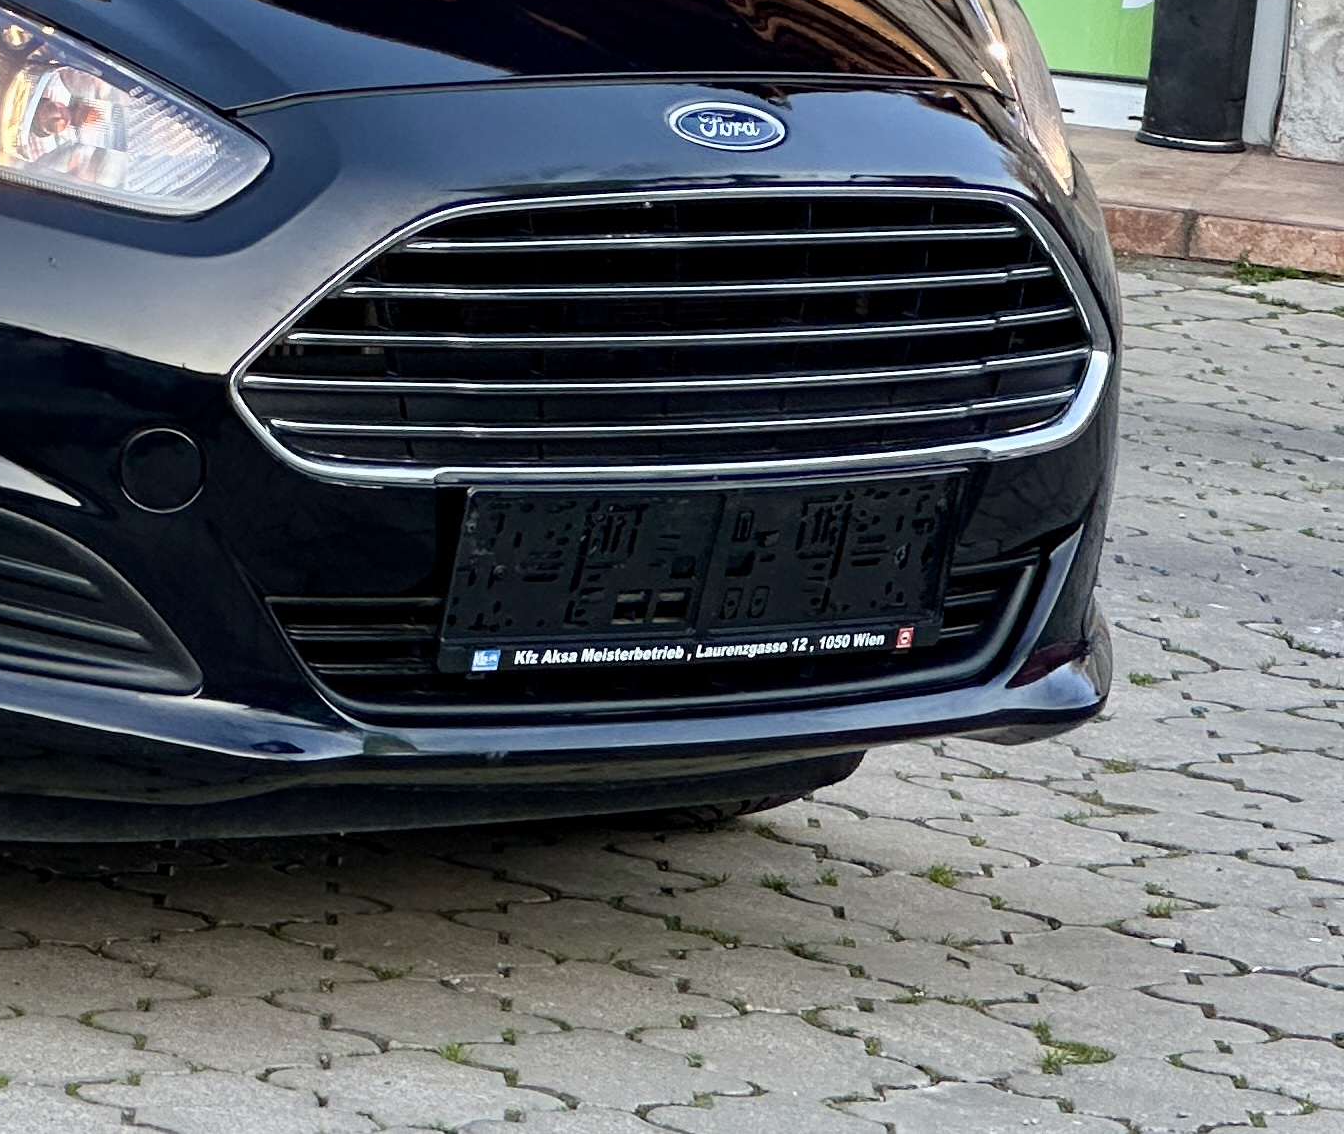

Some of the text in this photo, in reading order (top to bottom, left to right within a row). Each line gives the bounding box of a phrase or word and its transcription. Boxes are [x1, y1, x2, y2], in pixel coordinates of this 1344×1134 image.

[697, 111, 760, 137] Ford
[514, 650, 539, 665] Kfz
[541, 649, 577, 665] Aksa
[581, 645, 685, 664] Meisterbetrieb
[696, 641, 787, 659] Laurenzgasse
[791, 638, 807, 652] 12
[819, 634, 850, 649] 1050
[853, 632, 885, 647] Wien
